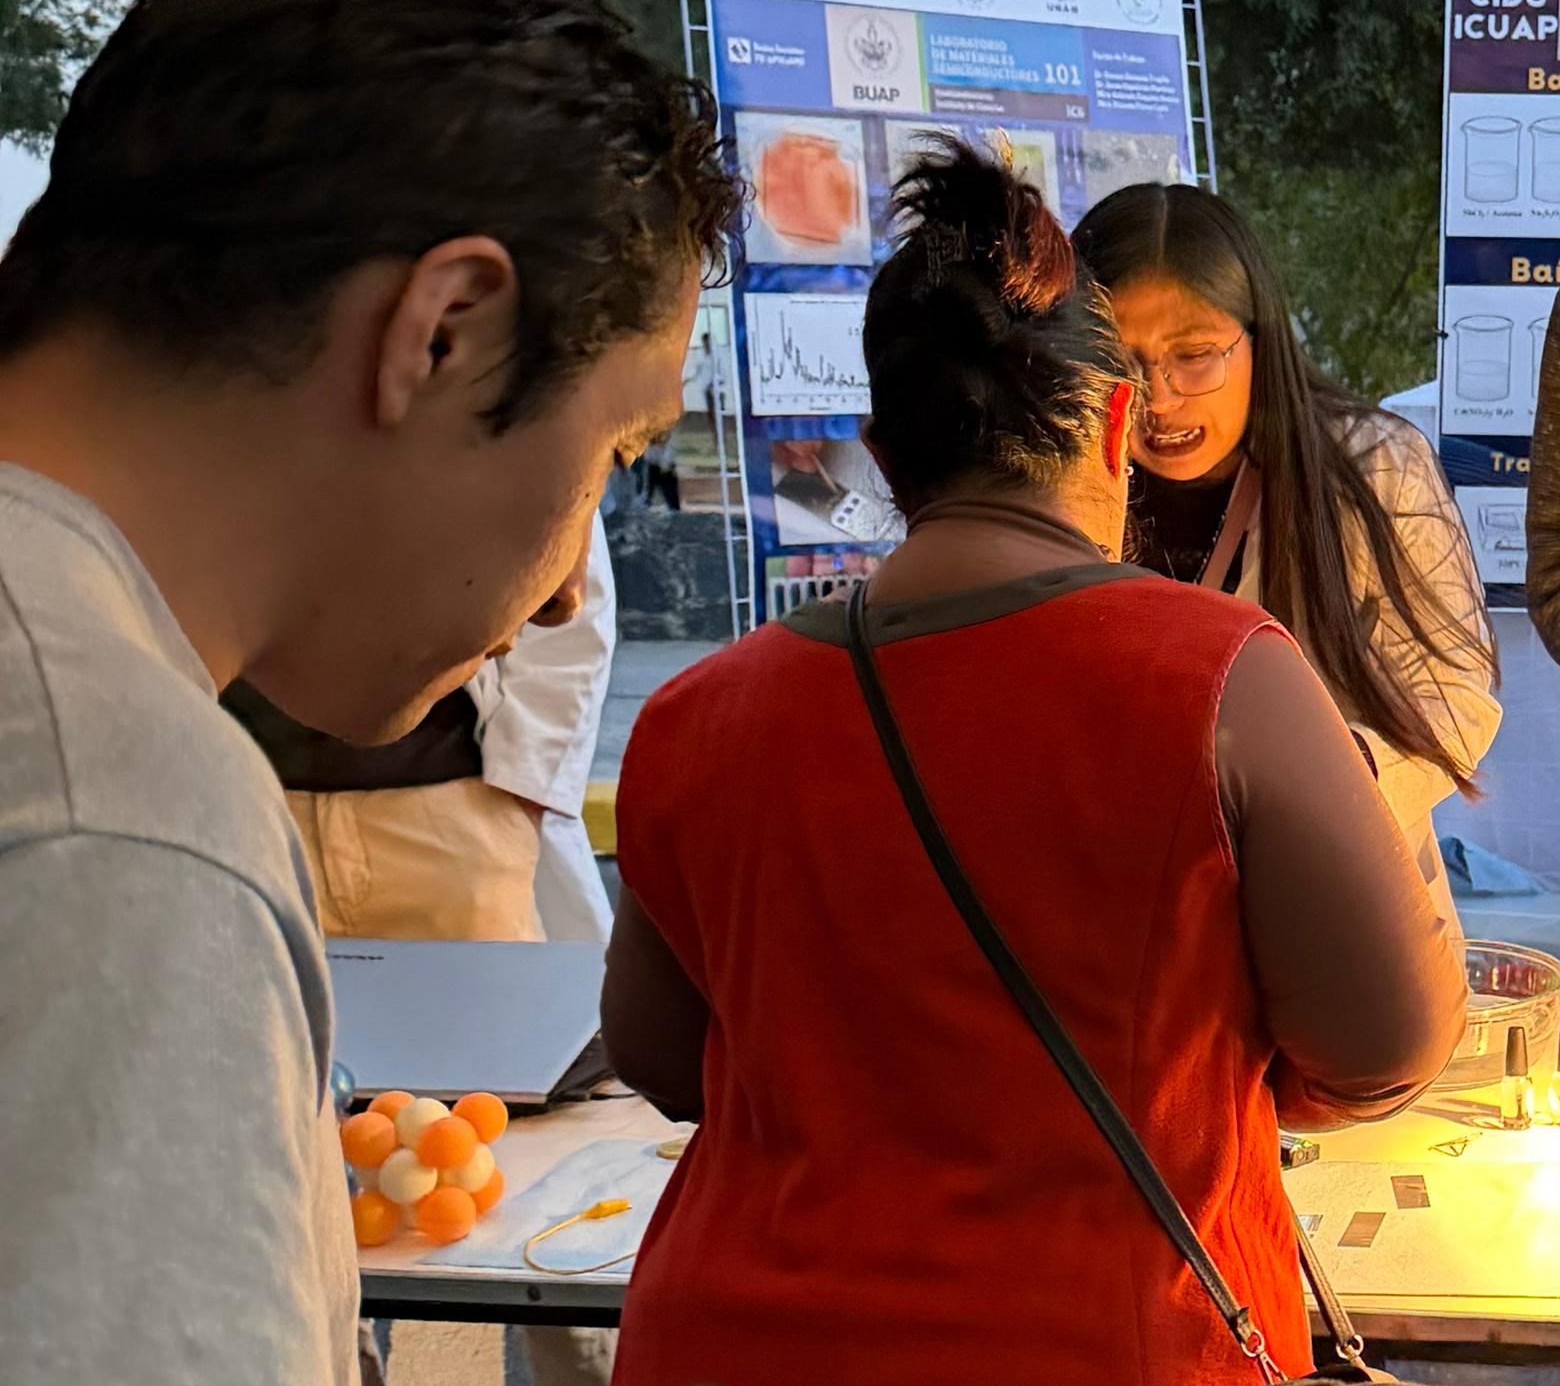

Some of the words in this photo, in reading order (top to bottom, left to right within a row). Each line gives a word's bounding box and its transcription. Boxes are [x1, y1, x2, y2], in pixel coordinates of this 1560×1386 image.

[1454, 13, 1559, 40] ICUAP
[1045, 63, 1082, 87] 101
[853, 85, 901, 103] BUAP
